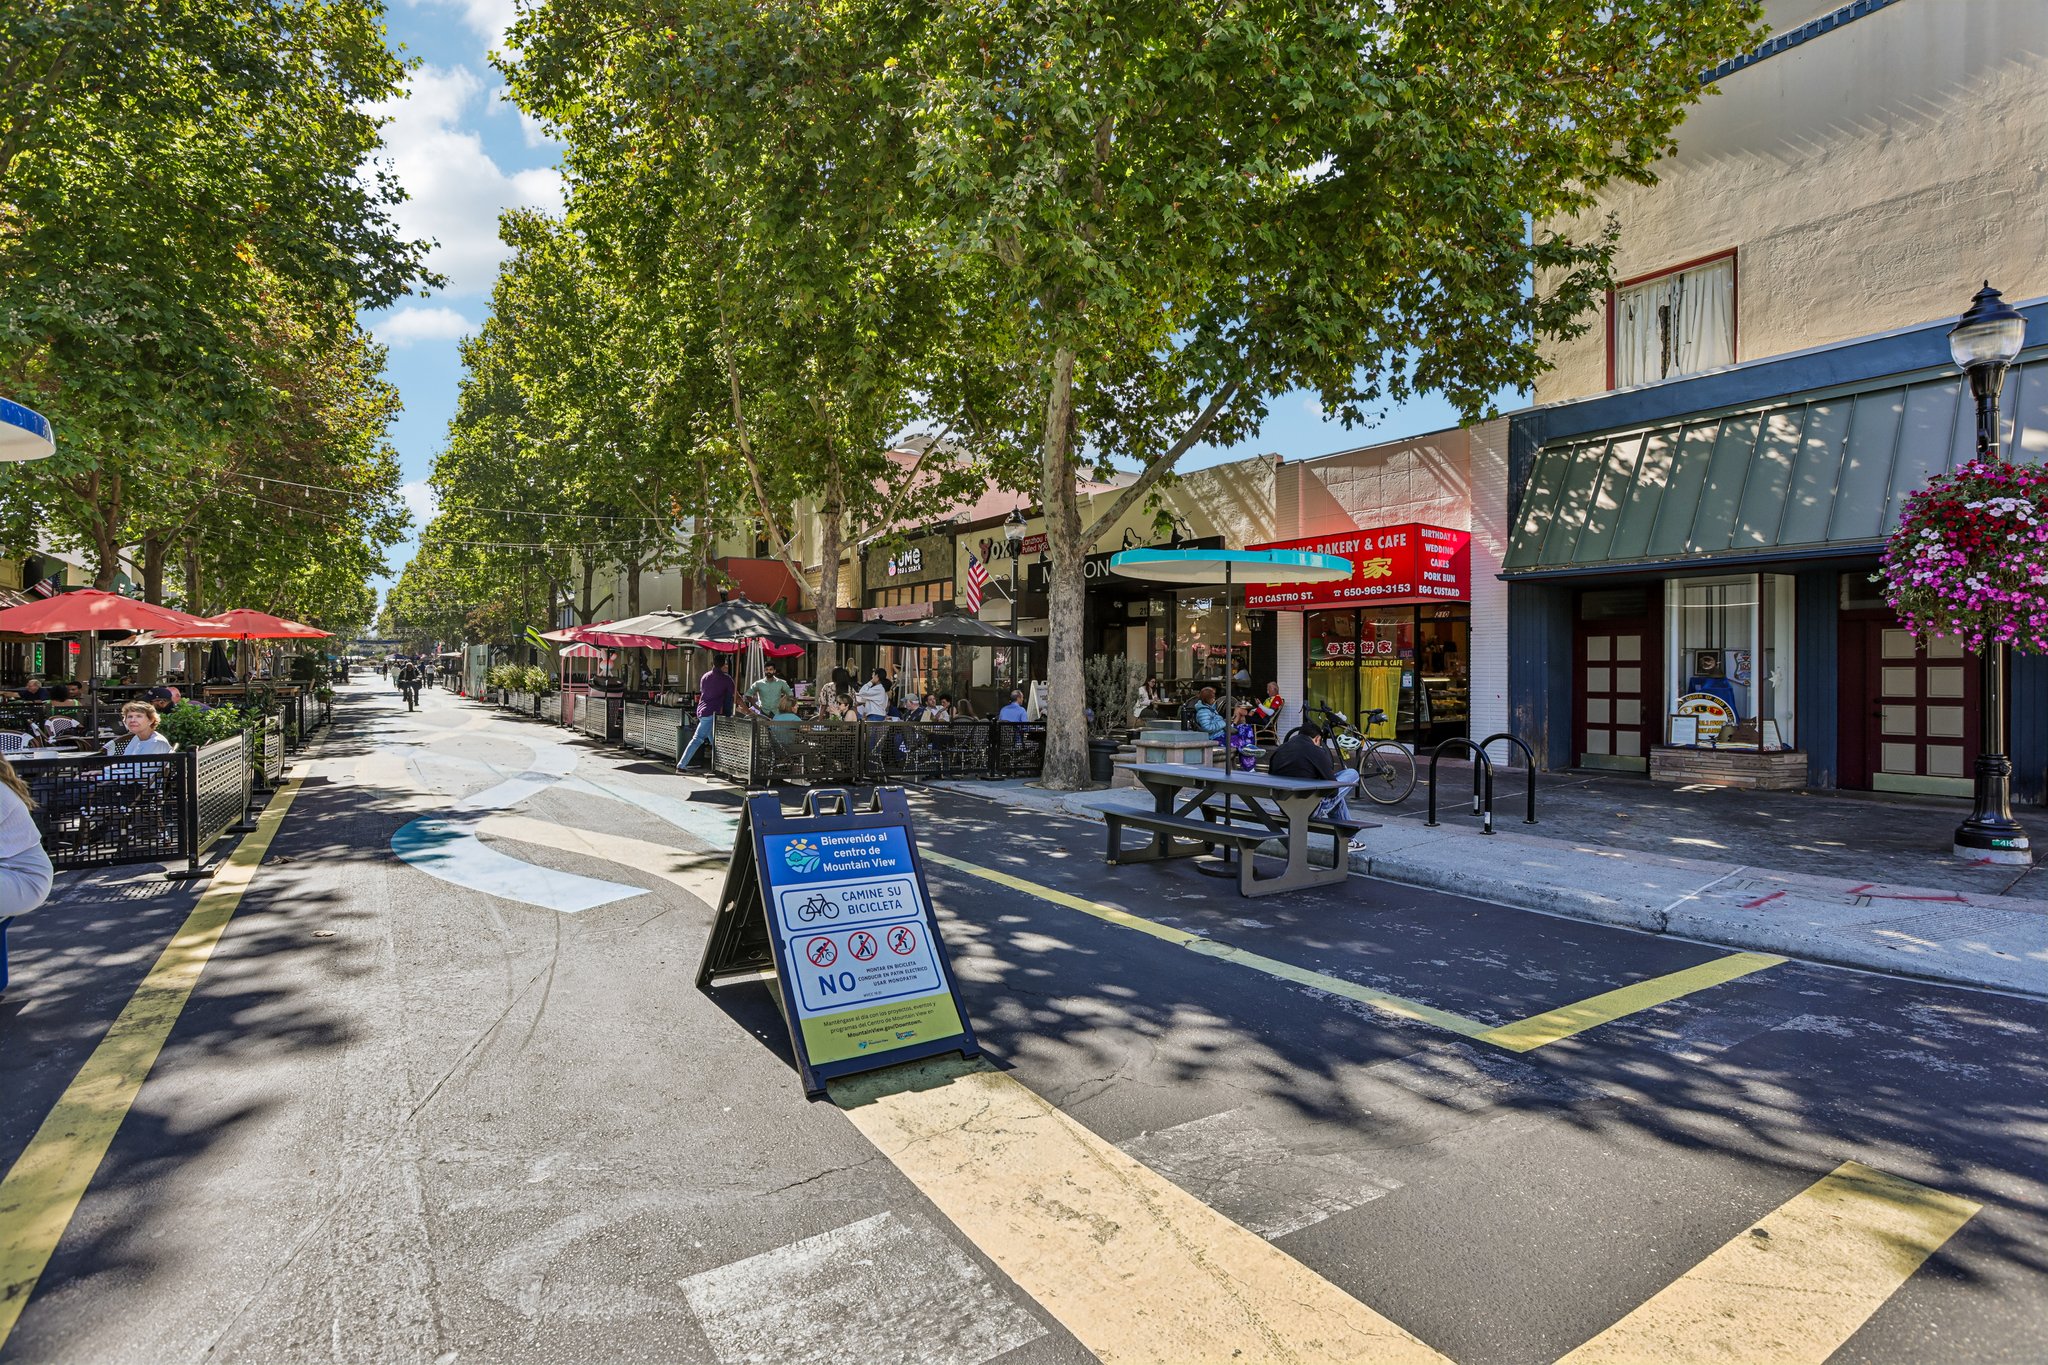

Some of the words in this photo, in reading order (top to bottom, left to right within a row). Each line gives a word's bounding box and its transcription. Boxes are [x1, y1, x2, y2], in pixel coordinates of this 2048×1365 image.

[1421, 529, 1451, 540] BIRTHDAY
[1317, 540, 1360, 556] BAKERY
[1364, 538, 1374, 551] &
[1377, 533, 1407, 549] CAFE
[1424, 543, 1455, 555] WEDDING
[1430, 558, 1450, 568] CAKES
[1424, 571, 1441, 582] PORK
[1442, 573, 1456, 583] BUN
[1343, 584, 1411, 597] 650-969-3153
[1418, 585, 1432, 595] EGG
[1433, 586, 1460, 597] CUSTARD
[1249, 596, 1263, 604] 210
[1265, 593, 1299, 603] CASTRO
[1301, 591, 1314, 600] ST.
[1335, 659, 1355, 667] KONG
[820, 833, 877, 846] Bienvenido
[878, 832, 888, 841] al
[833, 847, 867, 858] centro
[868, 846, 881, 855] de
[822, 860, 871, 873] Mountain
[871, 858, 896, 868] View
[841, 888, 884, 902] CAMINE
[887, 886, 902, 897] SU
[847, 899, 903, 915] BICICLETA
[866, 965, 886, 973] MONTAR
[894, 961, 917, 969] BICICLETA
[818, 971, 856, 996] NO
[857, 973, 882, 982] CONDUCIR
[830, 1024, 858, 1034] programas
[867, 1019, 885, 1028] Centro
[892, 1013, 915, 1022] Mountain
